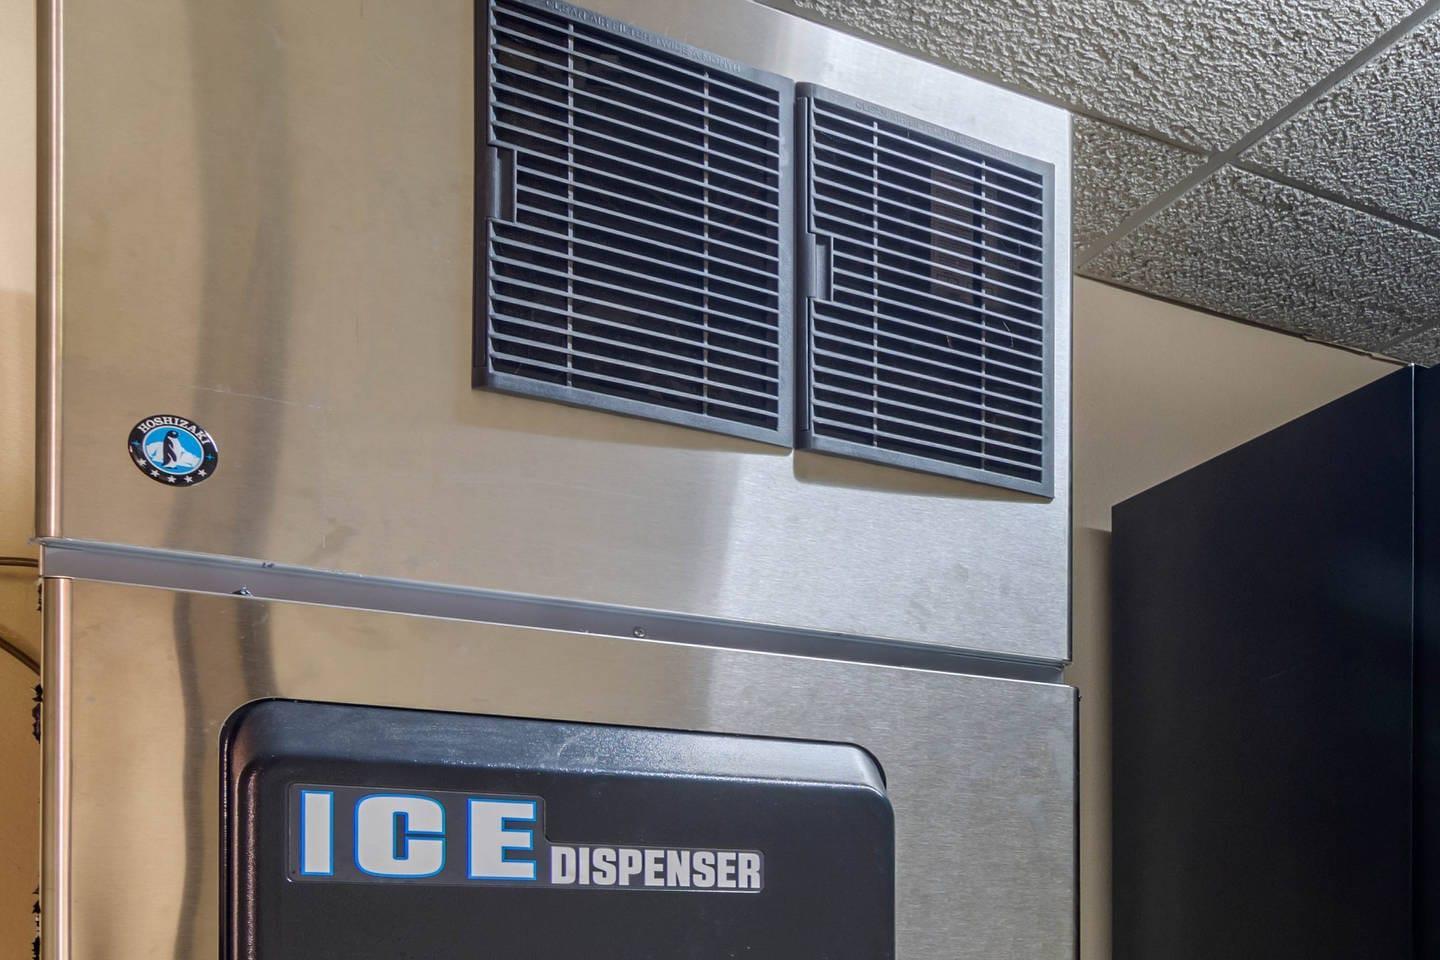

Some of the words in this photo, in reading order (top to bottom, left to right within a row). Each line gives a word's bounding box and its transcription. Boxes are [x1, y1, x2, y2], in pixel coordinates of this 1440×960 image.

[138, 417, 211, 444] HOSHIZAKI
[301, 789, 538, 881] ICE
[550, 845, 762, 889] DISPENSER
